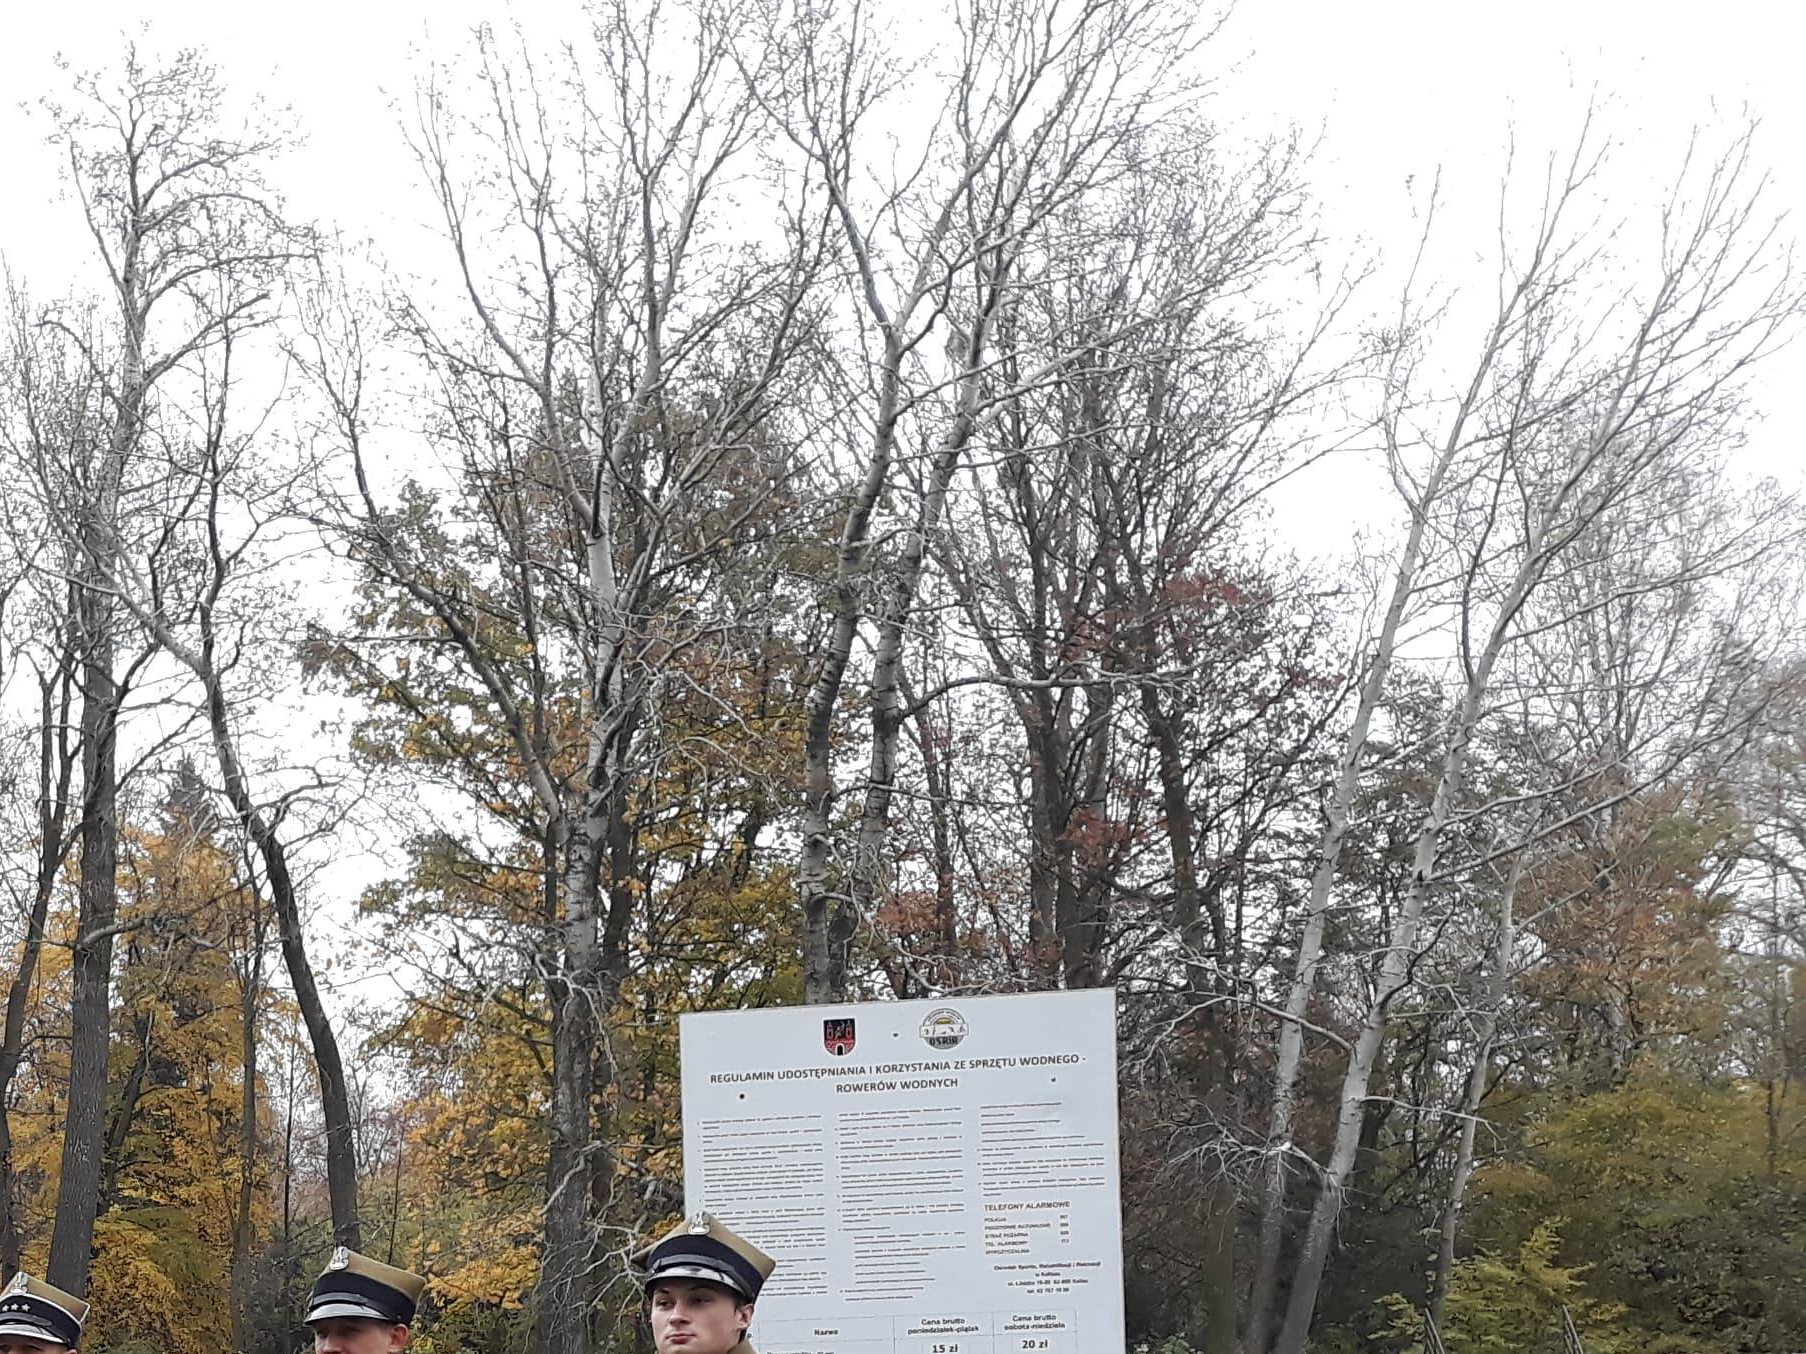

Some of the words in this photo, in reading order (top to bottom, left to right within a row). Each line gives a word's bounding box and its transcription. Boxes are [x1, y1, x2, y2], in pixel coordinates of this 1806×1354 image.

[710, 1070, 774, 1084] REGULAMIN
[777, 1065, 865, 1081] UDOSTĘPNIANIA
[876, 1061, 950, 1074] KORZYSTANIA
[953, 1060, 965, 1070] ZE
[969, 1058, 1016, 1070] SPRZĘTU
[1020, 1054, 1079, 1066] WODNEGO
[836, 1080, 897, 1093] ROWERÓW
[900, 1078, 958, 1089] WODNYCH
[984, 1203, 1023, 1212] TELEFONY
[1026, 1201, 1070, 1210] ALARMOWE
[932, 1344, 945, 1353] 15
[949, 1343, 958, 1353] zł
[1022, 1340, 1035, 1349] 20
[1038, 1339, 1048, 1348] zł
